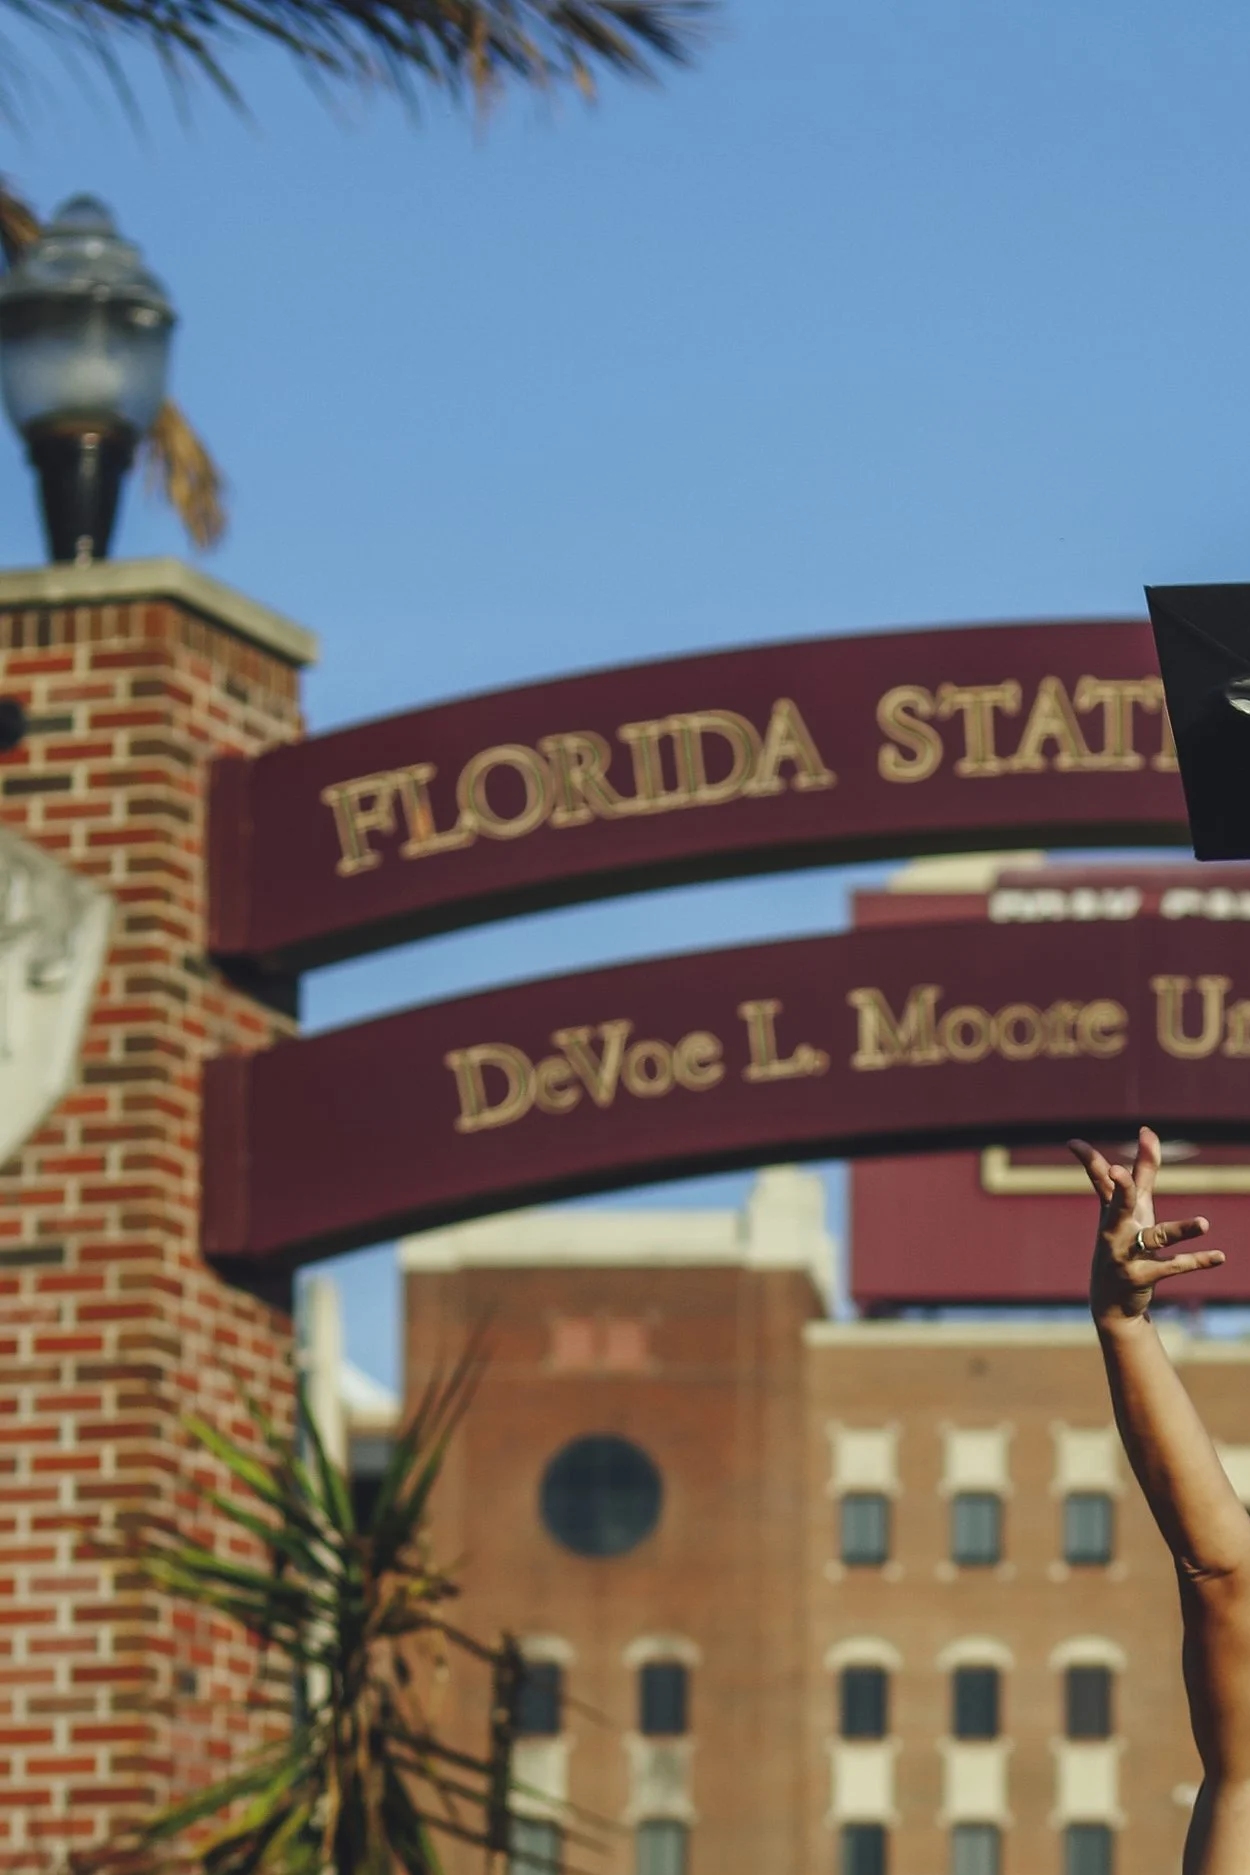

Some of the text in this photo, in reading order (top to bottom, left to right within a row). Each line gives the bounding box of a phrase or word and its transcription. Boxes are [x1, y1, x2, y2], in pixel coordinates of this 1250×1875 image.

[322, 698, 836, 876] FLORIDA
[876, 674, 1179, 782] STAT
[447, 1020, 724, 1132] DeVoe
[739, 1000, 828, 1081] L.
[849, 985, 1128, 1070] Moore
